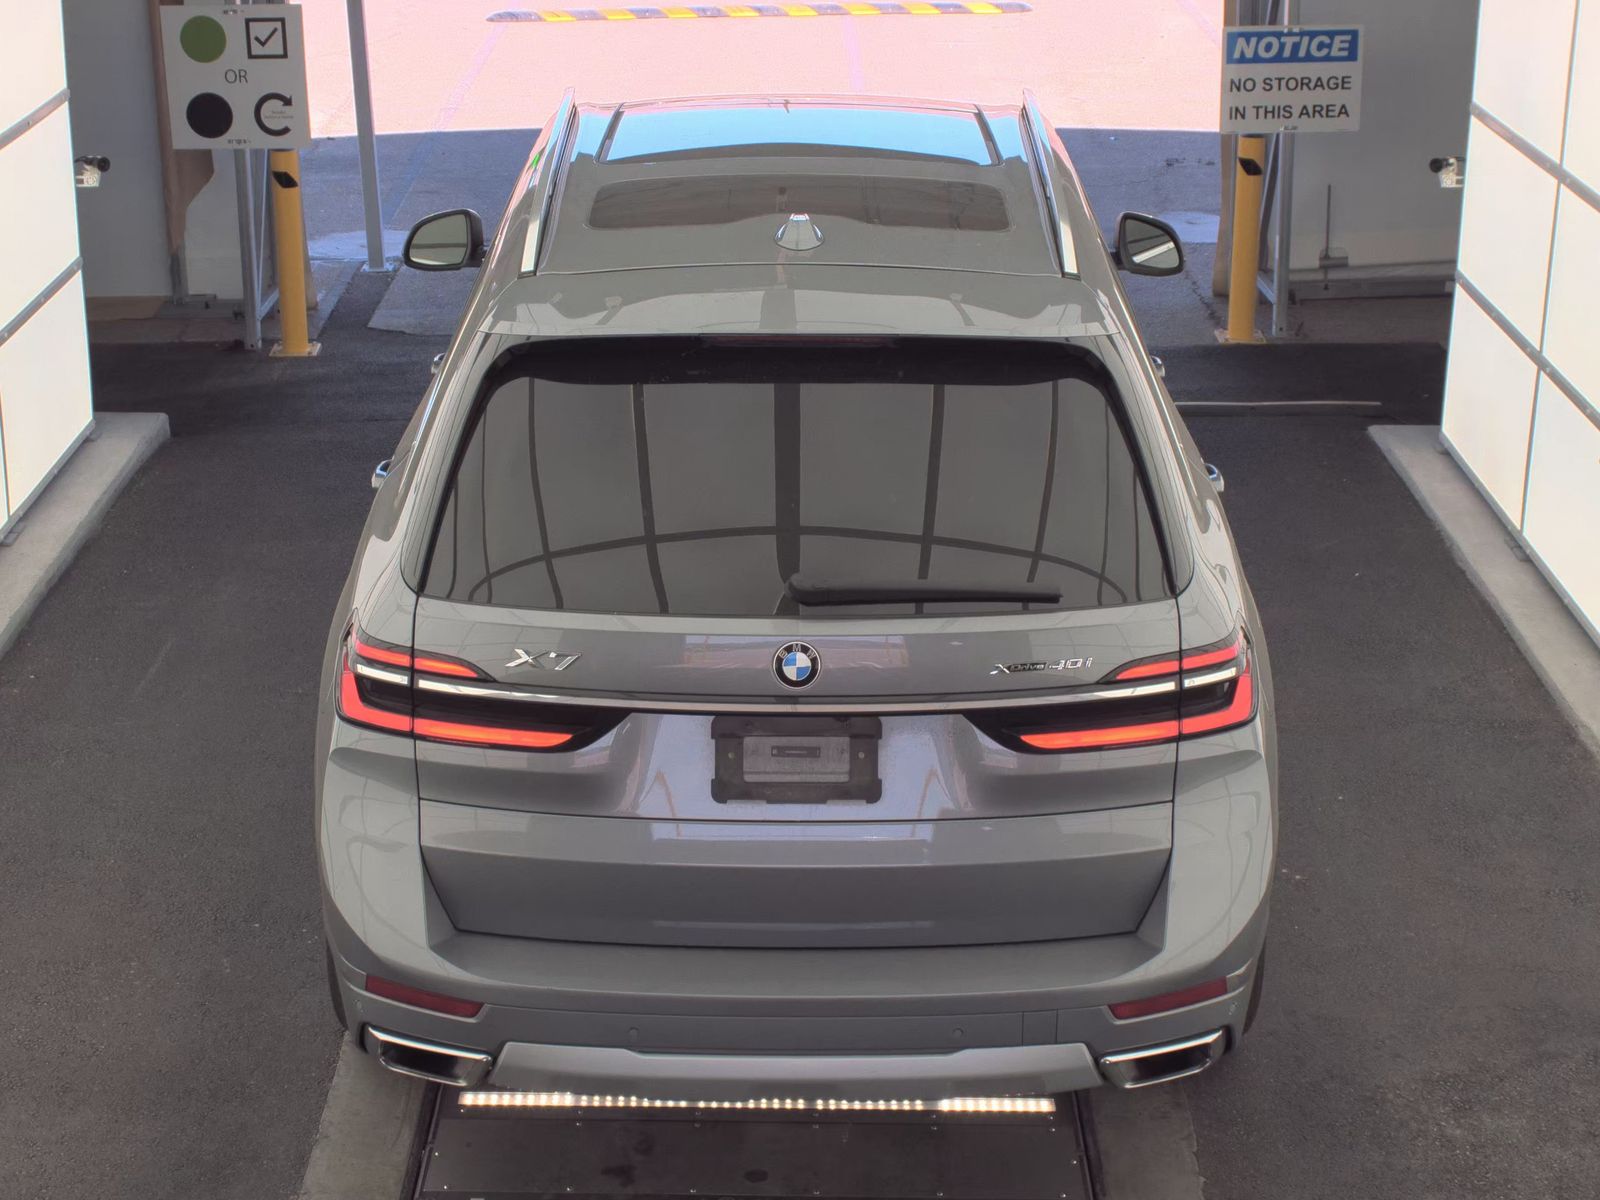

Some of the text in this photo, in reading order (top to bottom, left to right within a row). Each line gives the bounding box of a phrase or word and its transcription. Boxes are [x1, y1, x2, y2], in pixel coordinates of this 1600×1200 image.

[1233, 35, 1352, 59] NOTICE
[224, 69, 248, 84] OR
[1229, 75, 1352, 92] NO STORAGE
[1229, 104, 1350, 120] IN THIS AREA
[778, 643, 817, 659] BMW
[504, 648, 582, 671] X7
